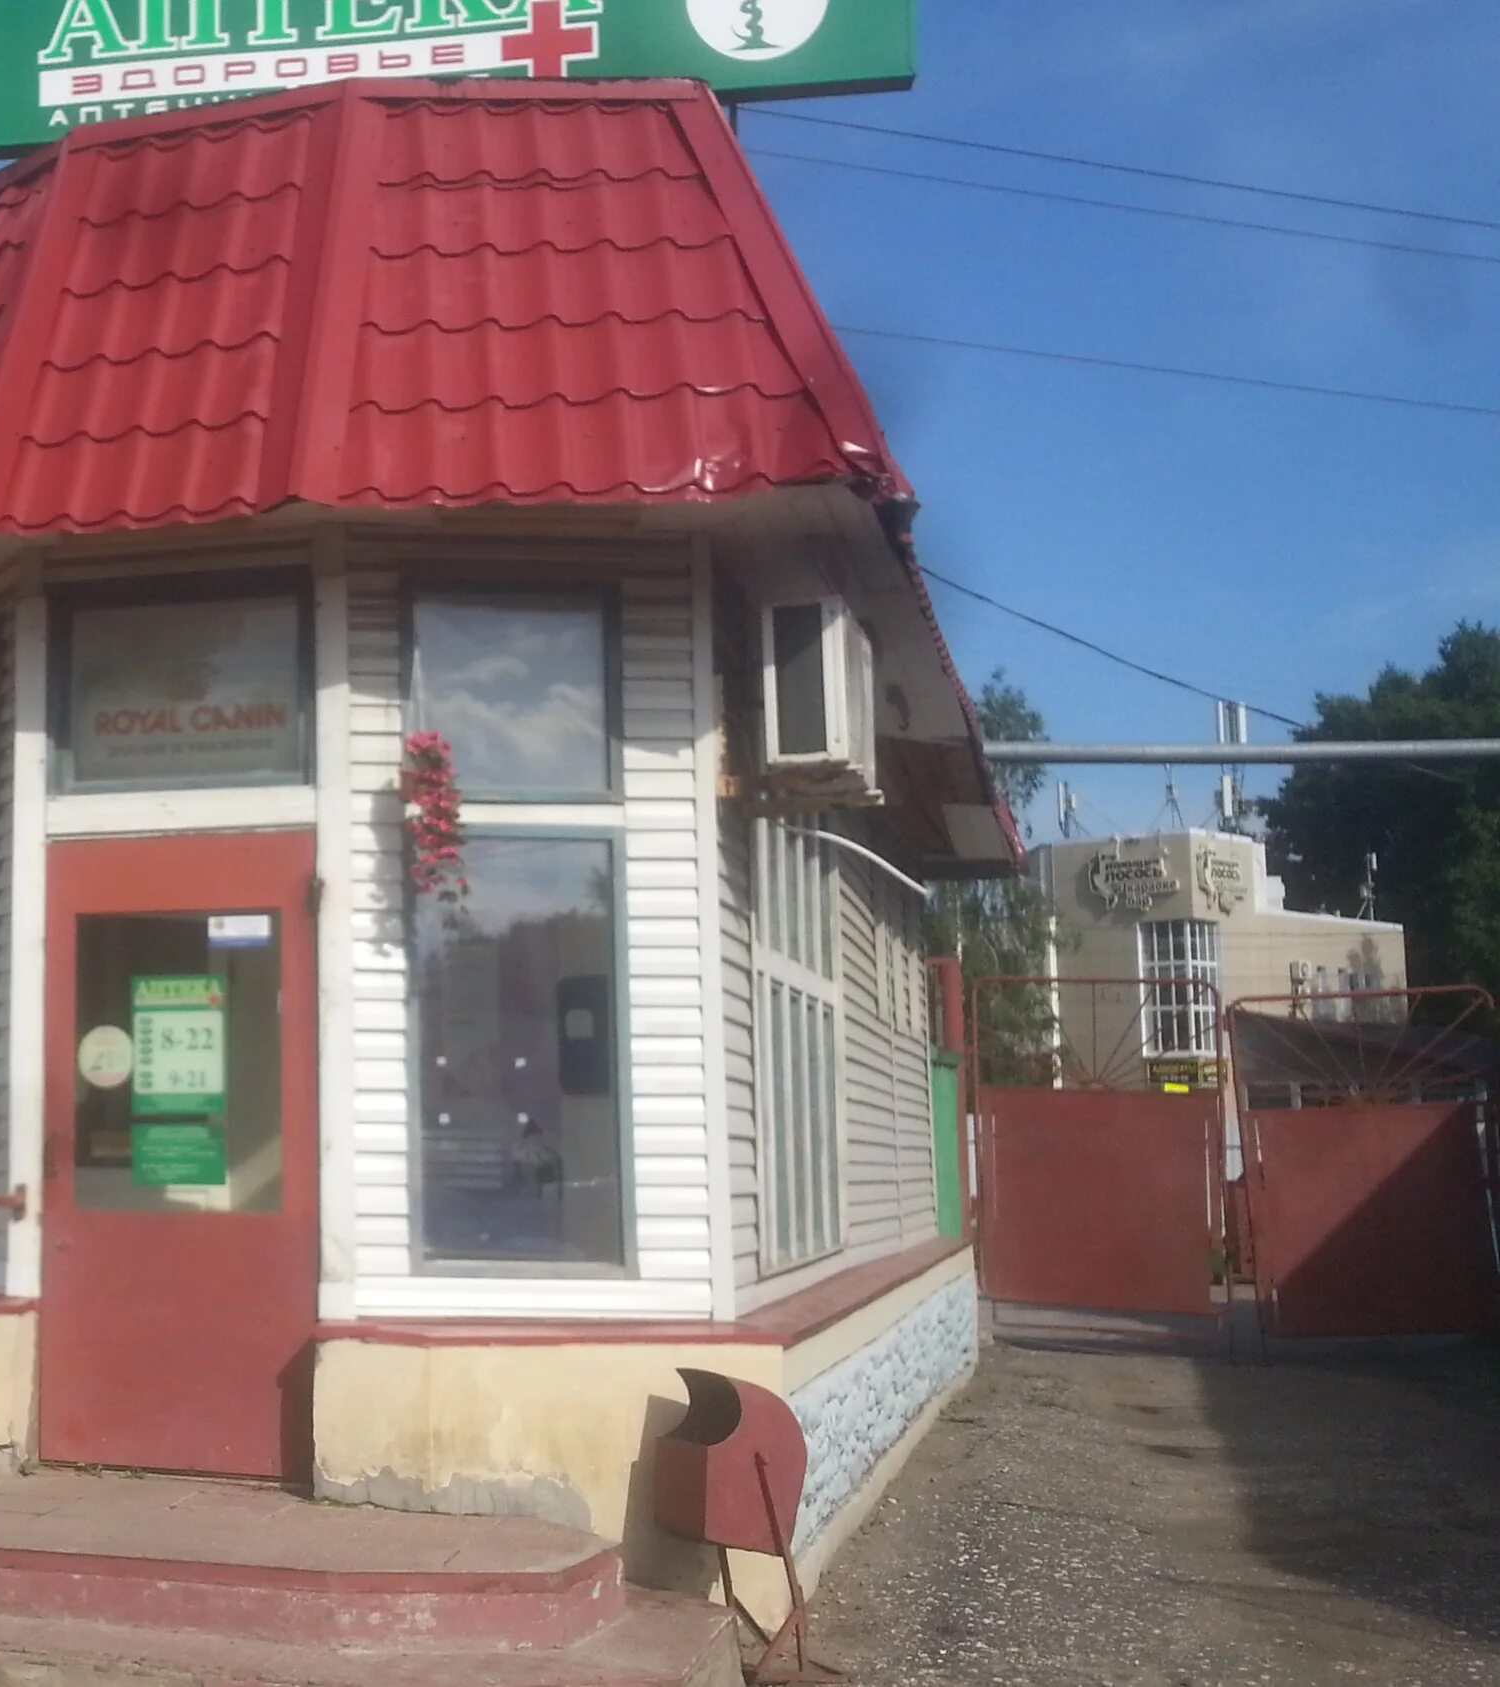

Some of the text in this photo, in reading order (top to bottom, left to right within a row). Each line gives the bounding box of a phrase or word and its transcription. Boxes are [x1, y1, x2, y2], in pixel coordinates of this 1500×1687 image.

[37, 0, 603, 64] АПТЕ
[71, 43, 465, 96] ЗДОРОВЬЕ
[94, 709, 183, 736] ROYAL
